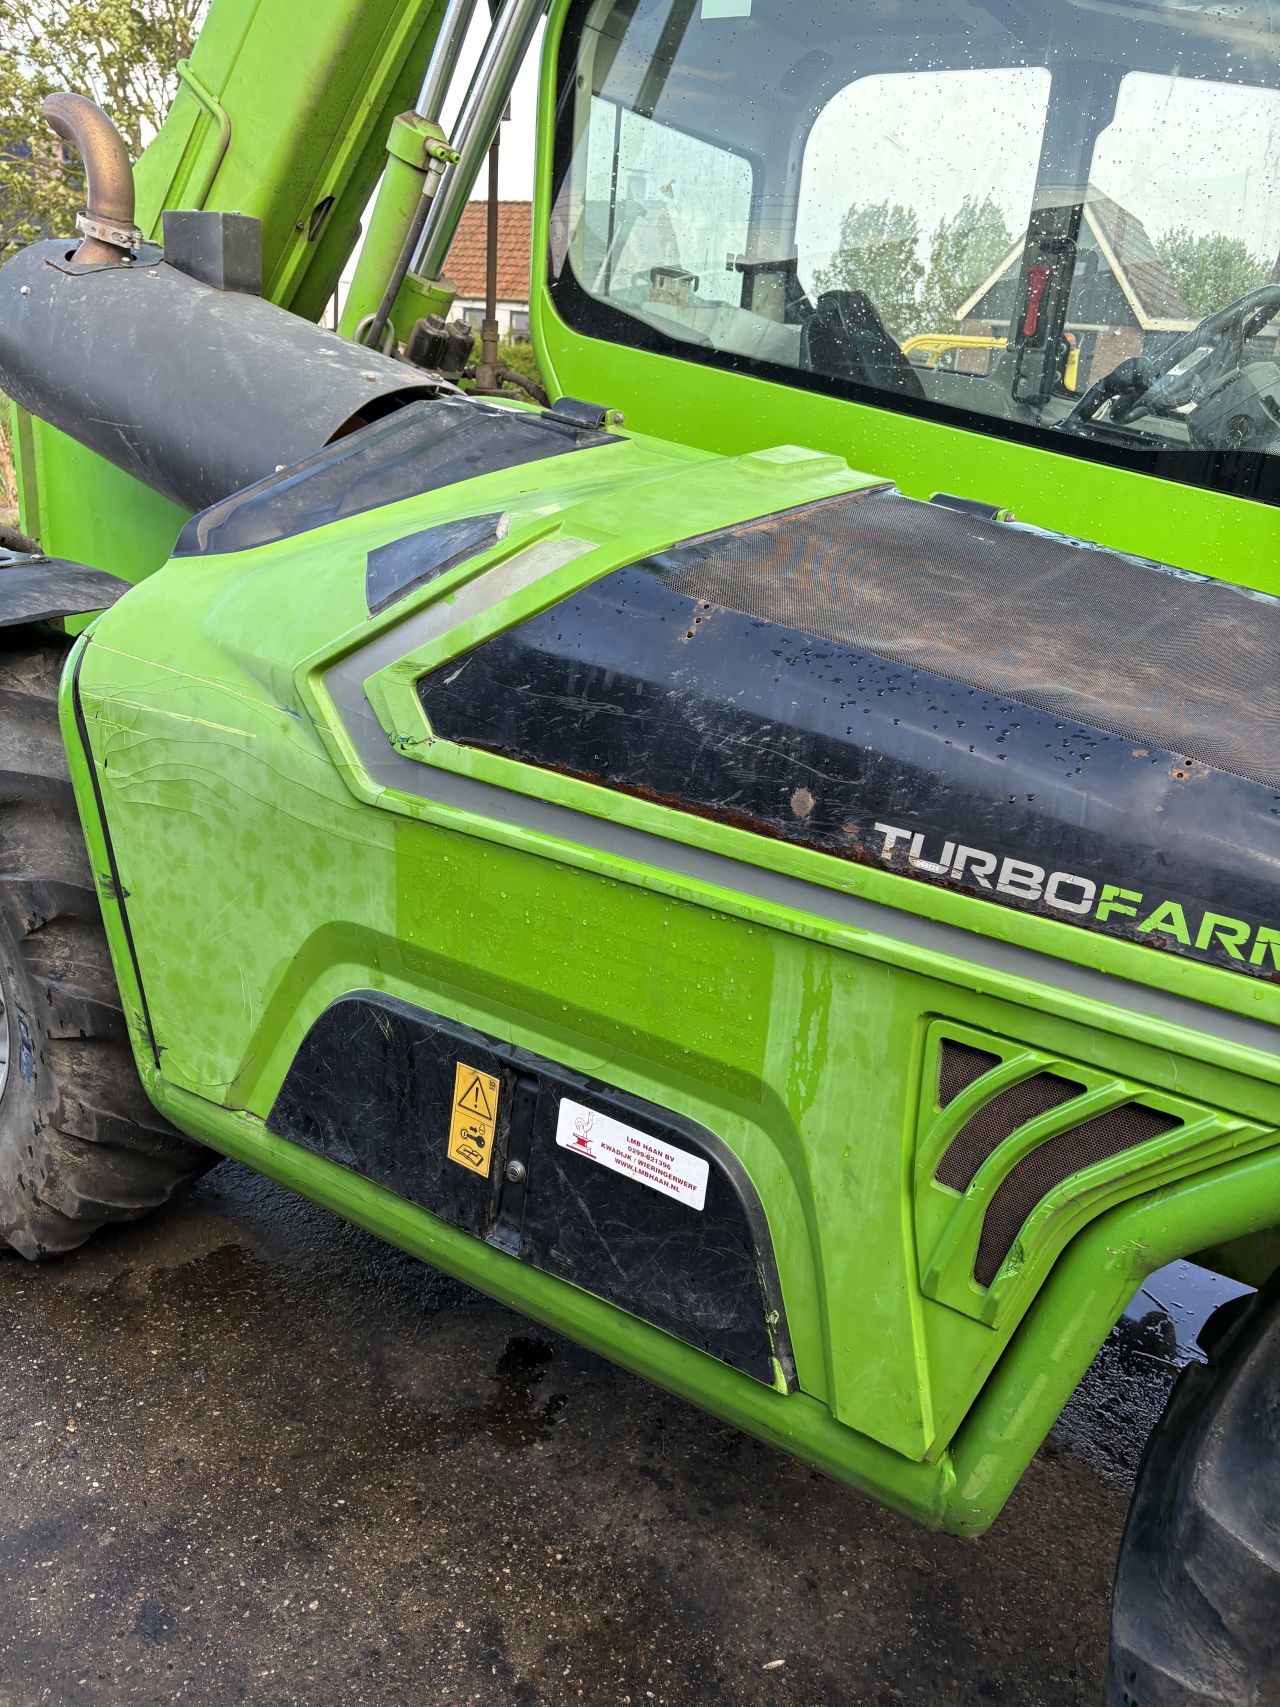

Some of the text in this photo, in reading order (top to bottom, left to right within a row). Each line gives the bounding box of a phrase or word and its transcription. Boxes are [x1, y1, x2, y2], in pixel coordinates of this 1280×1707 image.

[626, 1136, 675, 1162] LMB HAAN BV
[627, 1146, 671, 1170] 0299-621396
[600, 1142, 632, 1161] KWADIJK
[638, 1159, 698, 1191] WIERINGERWERF
[614, 1157, 680, 1193] WWW.LMBHAAN.NL
